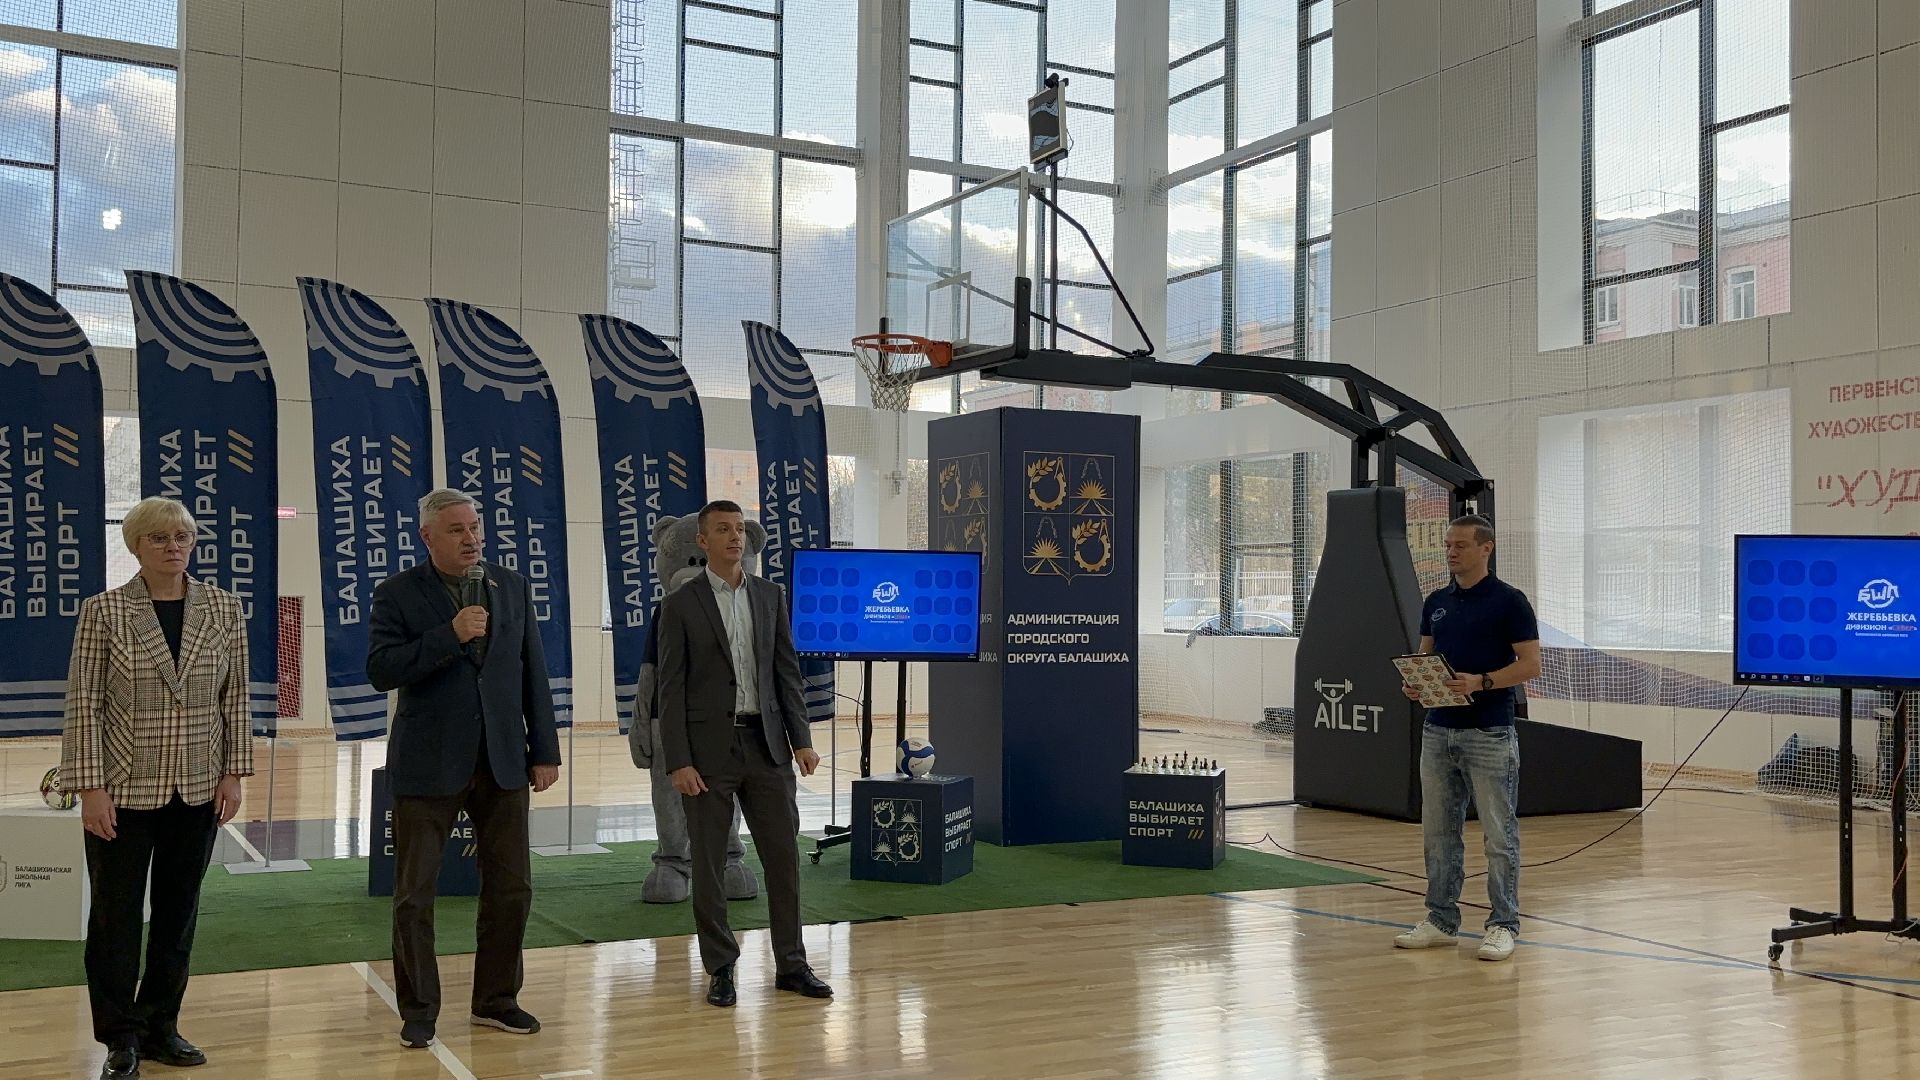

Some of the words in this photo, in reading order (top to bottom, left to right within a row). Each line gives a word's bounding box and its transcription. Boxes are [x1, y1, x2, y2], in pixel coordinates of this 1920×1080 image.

[492, 446, 517, 571] БИРАЕТ
[23, 425, 47, 618] ВЫБИРАЕТ
[331, 436, 360, 625] БАЛАШИХА
[615, 454, 644, 628] БАЛАШИХА
[57, 501, 80, 617] СПОРТ
[527, 517, 551, 621] СПОРТ
[1007, 613, 1120, 625] АДМИНИСТРАЦИЯ
[1846, 612, 1917, 622] ЖЕРЕБЬЕВКА
[1007, 633, 1090, 645] ГОРОДСКОГО
[1007, 653, 1056, 664] ОКРУГА
[1058, 653, 1129, 663] БАЛАШИХА
[1129, 800, 1205, 813] БАЛАШИХА
[1129, 813, 1205, 826] ВЫБИРАЕТ
[945, 819, 972, 838] ВЫБИРАЕТ
[1129, 827, 1174, 838] СПОРТ
[944, 837, 963, 853] СПОРТ
[15, 881, 32, 889] ЛИГА
